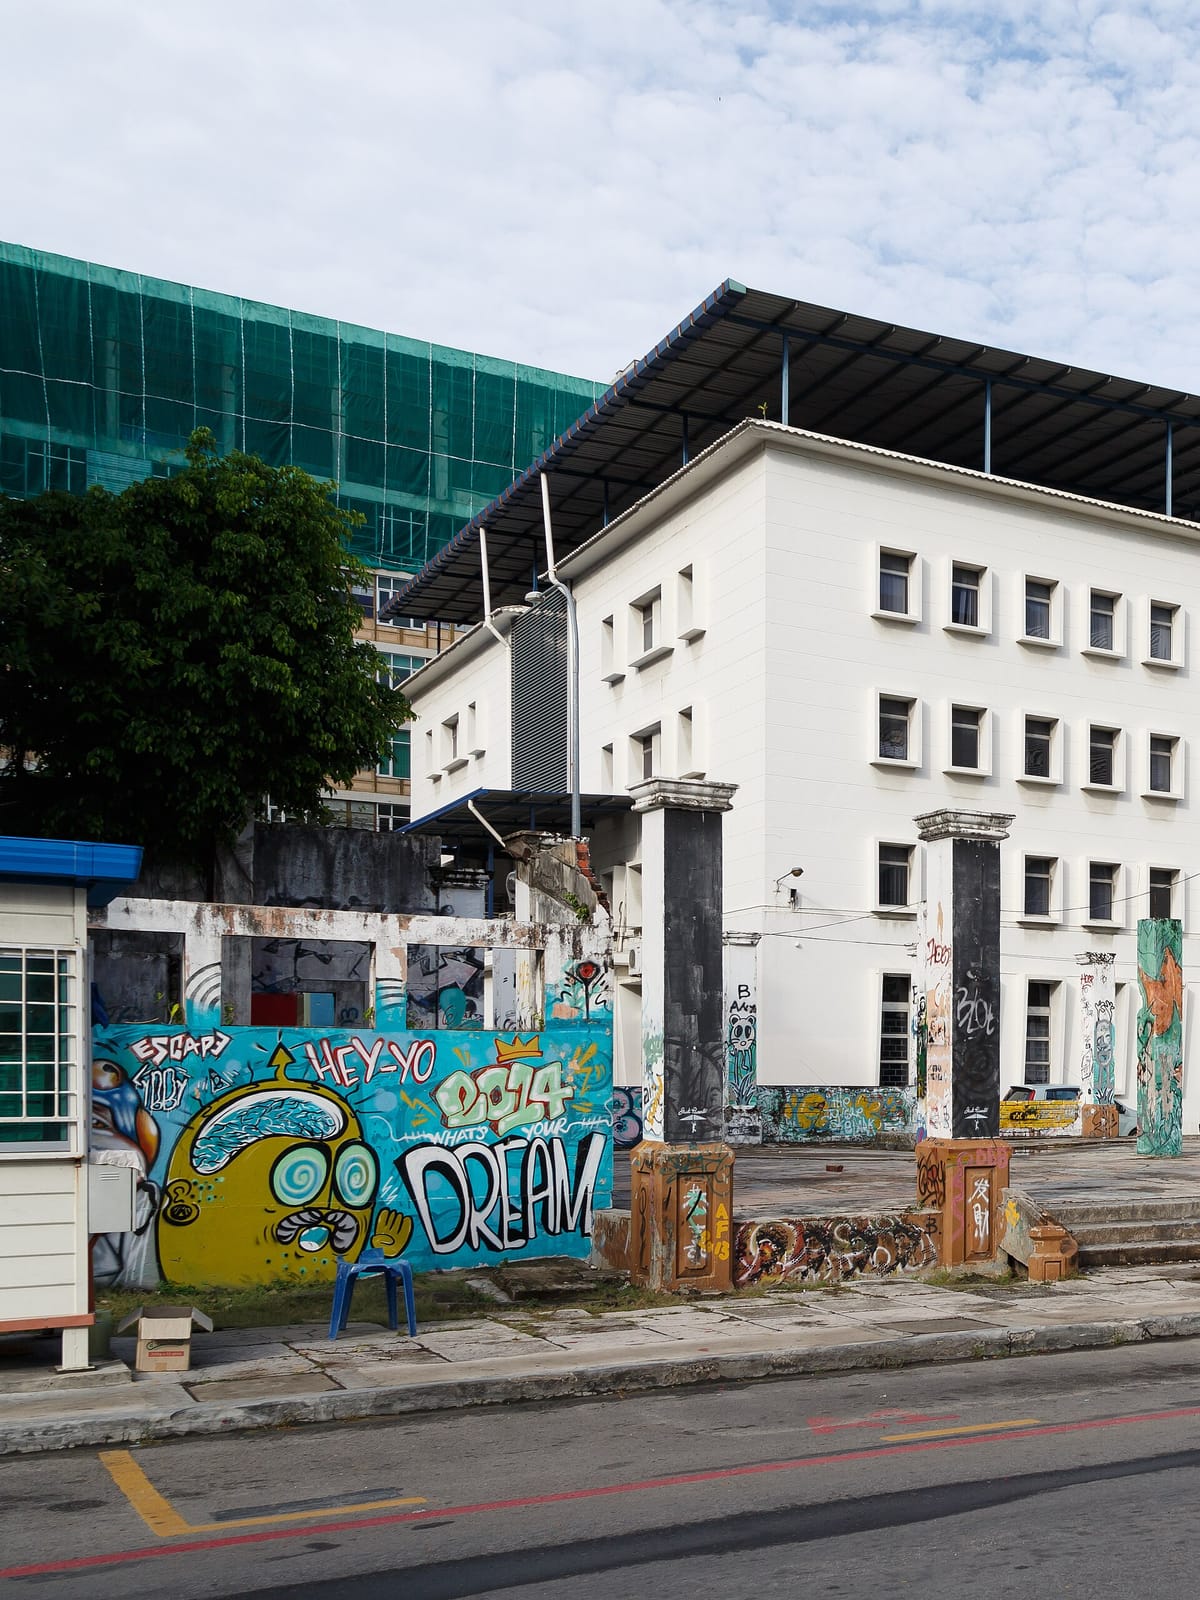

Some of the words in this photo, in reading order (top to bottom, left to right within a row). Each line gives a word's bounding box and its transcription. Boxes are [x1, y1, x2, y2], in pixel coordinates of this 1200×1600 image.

[304, 1036, 437, 1087] HEY-YO
[430, 1061, 576, 1136] 2014
[430, 1125, 489, 1145] WHAT'S
[521, 1117, 569, 1140] YOUR
[393, 1131, 608, 1255] DREAM
